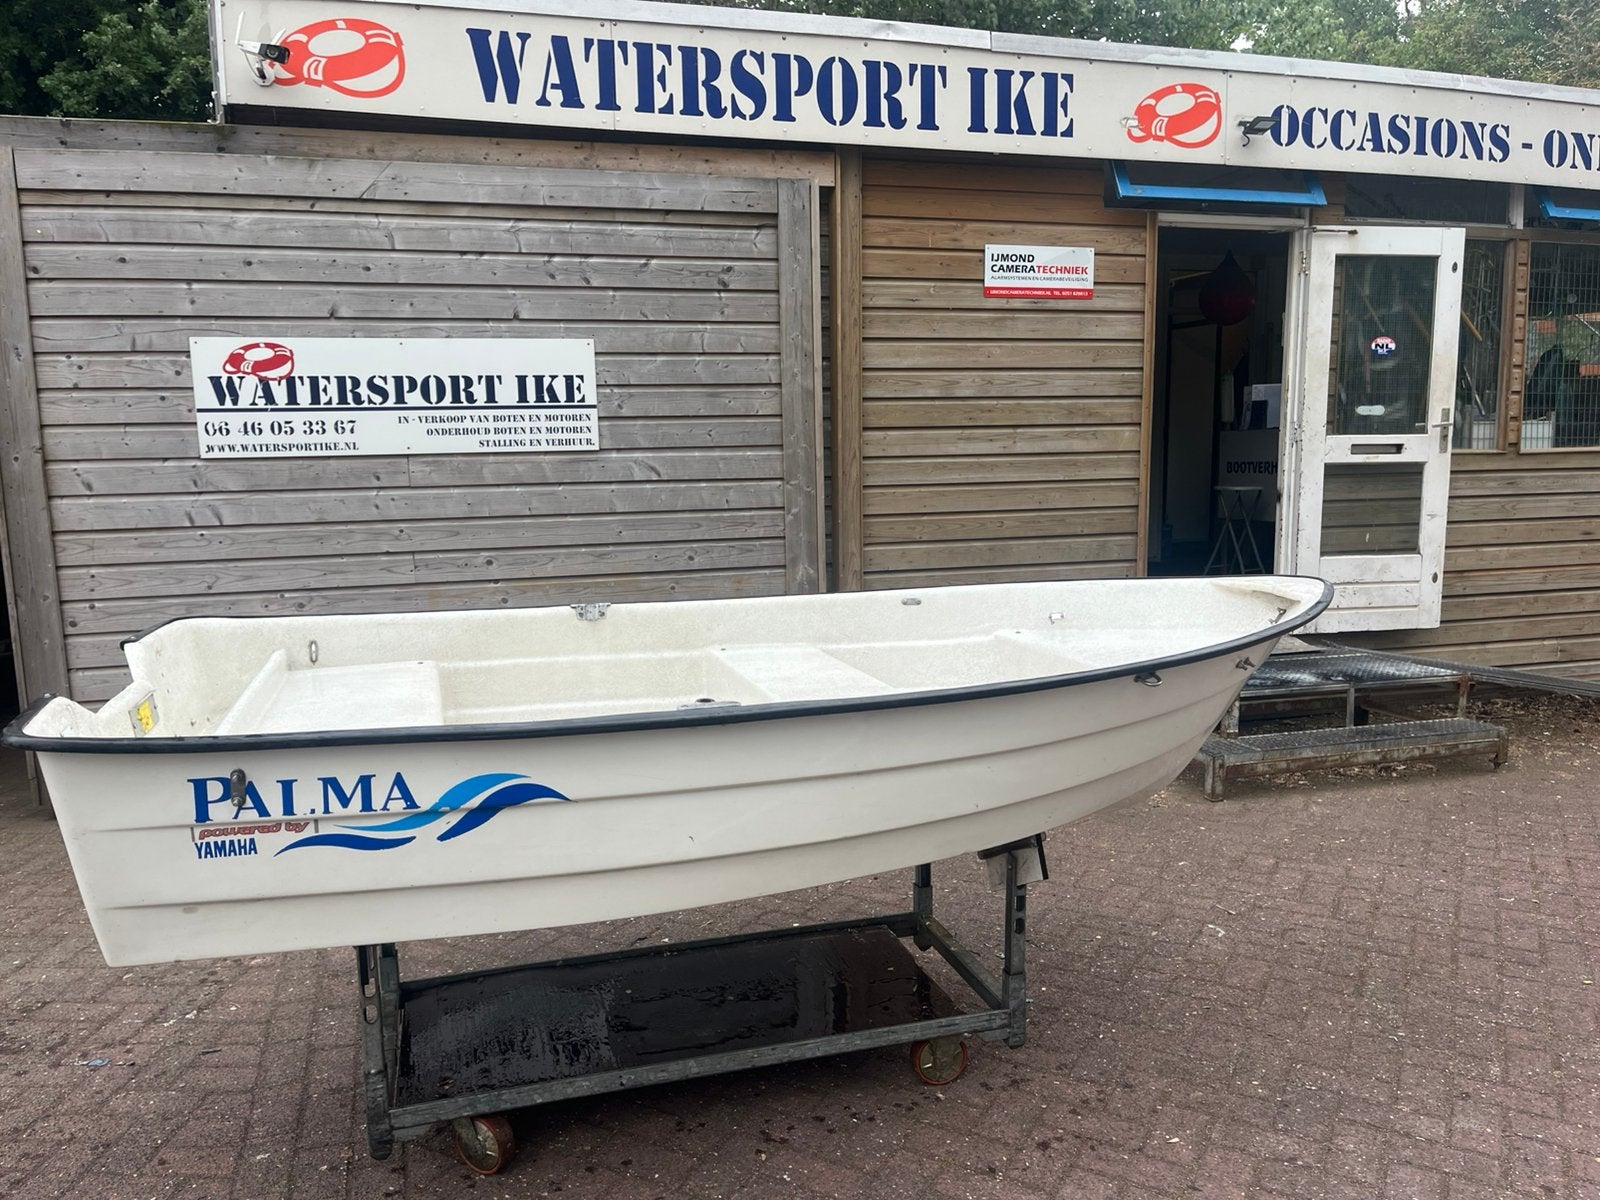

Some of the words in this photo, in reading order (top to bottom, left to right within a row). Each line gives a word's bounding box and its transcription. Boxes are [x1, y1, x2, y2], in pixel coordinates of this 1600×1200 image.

[465, 28, 947, 132] WATERSPORT
[967, 66, 1074, 138] IKE
[1269, 104, 1511, 164] OCCASIONS
[1543, 129, 1600, 172] ON
[991, 253, 1035, 263] IJMOND
[990, 264, 1089, 275] CAMERATECHNIEK
[1039, 275, 1089, 283] CAMERABEVEILIGING
[208, 375, 503, 406] WATERSPORT
[515, 374, 586, 404] IKE
[398, 416, 409, 424] IN
[418, 415, 467, 424] VERKOOP
[470, 415, 490, 423] VAN
[493, 414, 527, 423] BOTEN
[529, 414, 542, 423] EN
[544, 413, 592, 423] MOTOREN
[204, 420, 231, 437] 06
[238, 420, 263, 437] 46
[270, 420, 295, 436] 05
[302, 419, 327, 436] 33
[334, 419, 357, 435] 67
[426, 427, 491, 437] ONDERHOUD
[493, 427, 527, 436] BOTEN
[529, 427, 542, 435] EN
[544, 426, 592, 435] MOTOREN
[205, 441, 360, 454] WWW.WATERSPORTIKE.NL
[478, 439, 527, 448] STALLING
[529, 438, 542, 447] EN
[545, 437, 596, 447] VERHUUR.
[187, 771, 421, 824] PALMA
[199, 822, 282, 841] powered
[284, 821, 310, 833] by
[194, 838, 258, 860] YAMAHA
